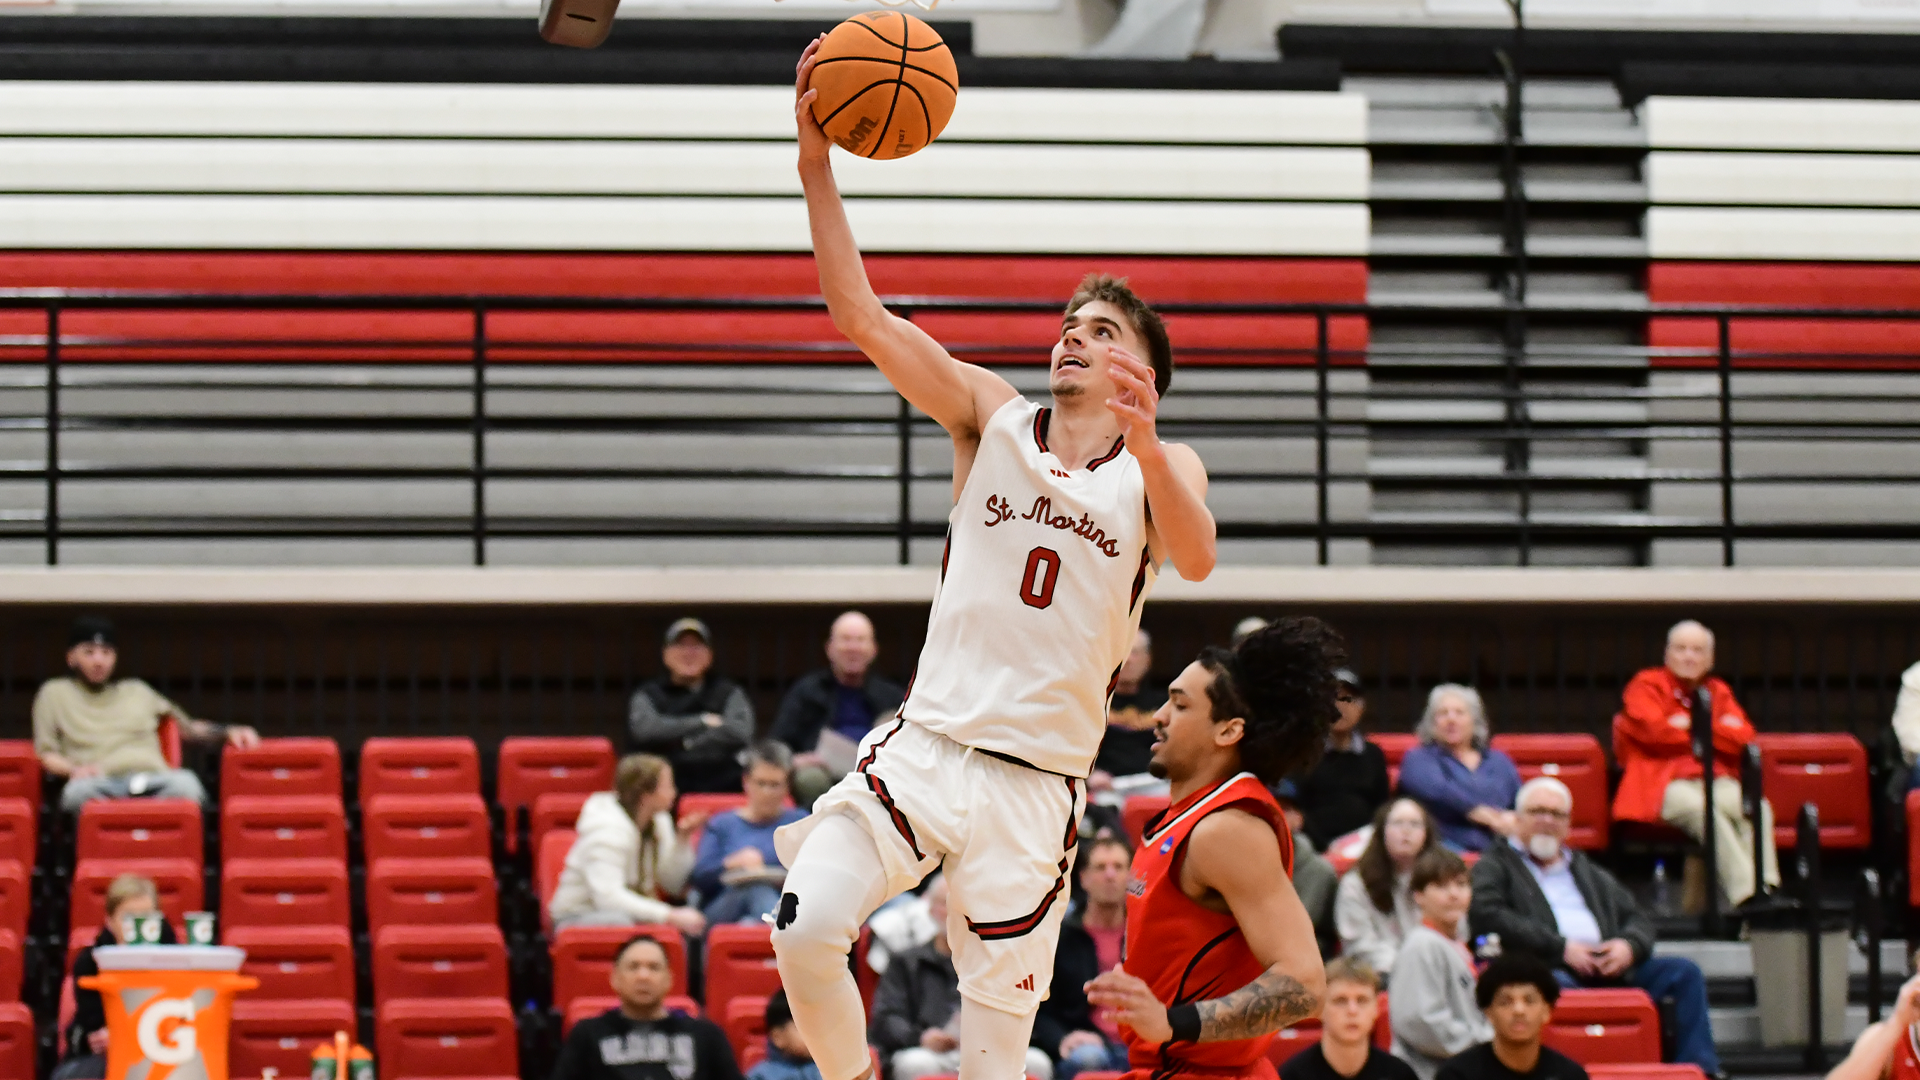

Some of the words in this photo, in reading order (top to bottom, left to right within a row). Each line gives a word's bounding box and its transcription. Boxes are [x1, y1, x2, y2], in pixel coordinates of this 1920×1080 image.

[834, 116, 880, 151] lson
[985, 494, 1016, 527] St.
[1022, 496, 1120, 557] Martins
[1019, 546, 1061, 610] 0
[138, 999, 196, 1064] G
